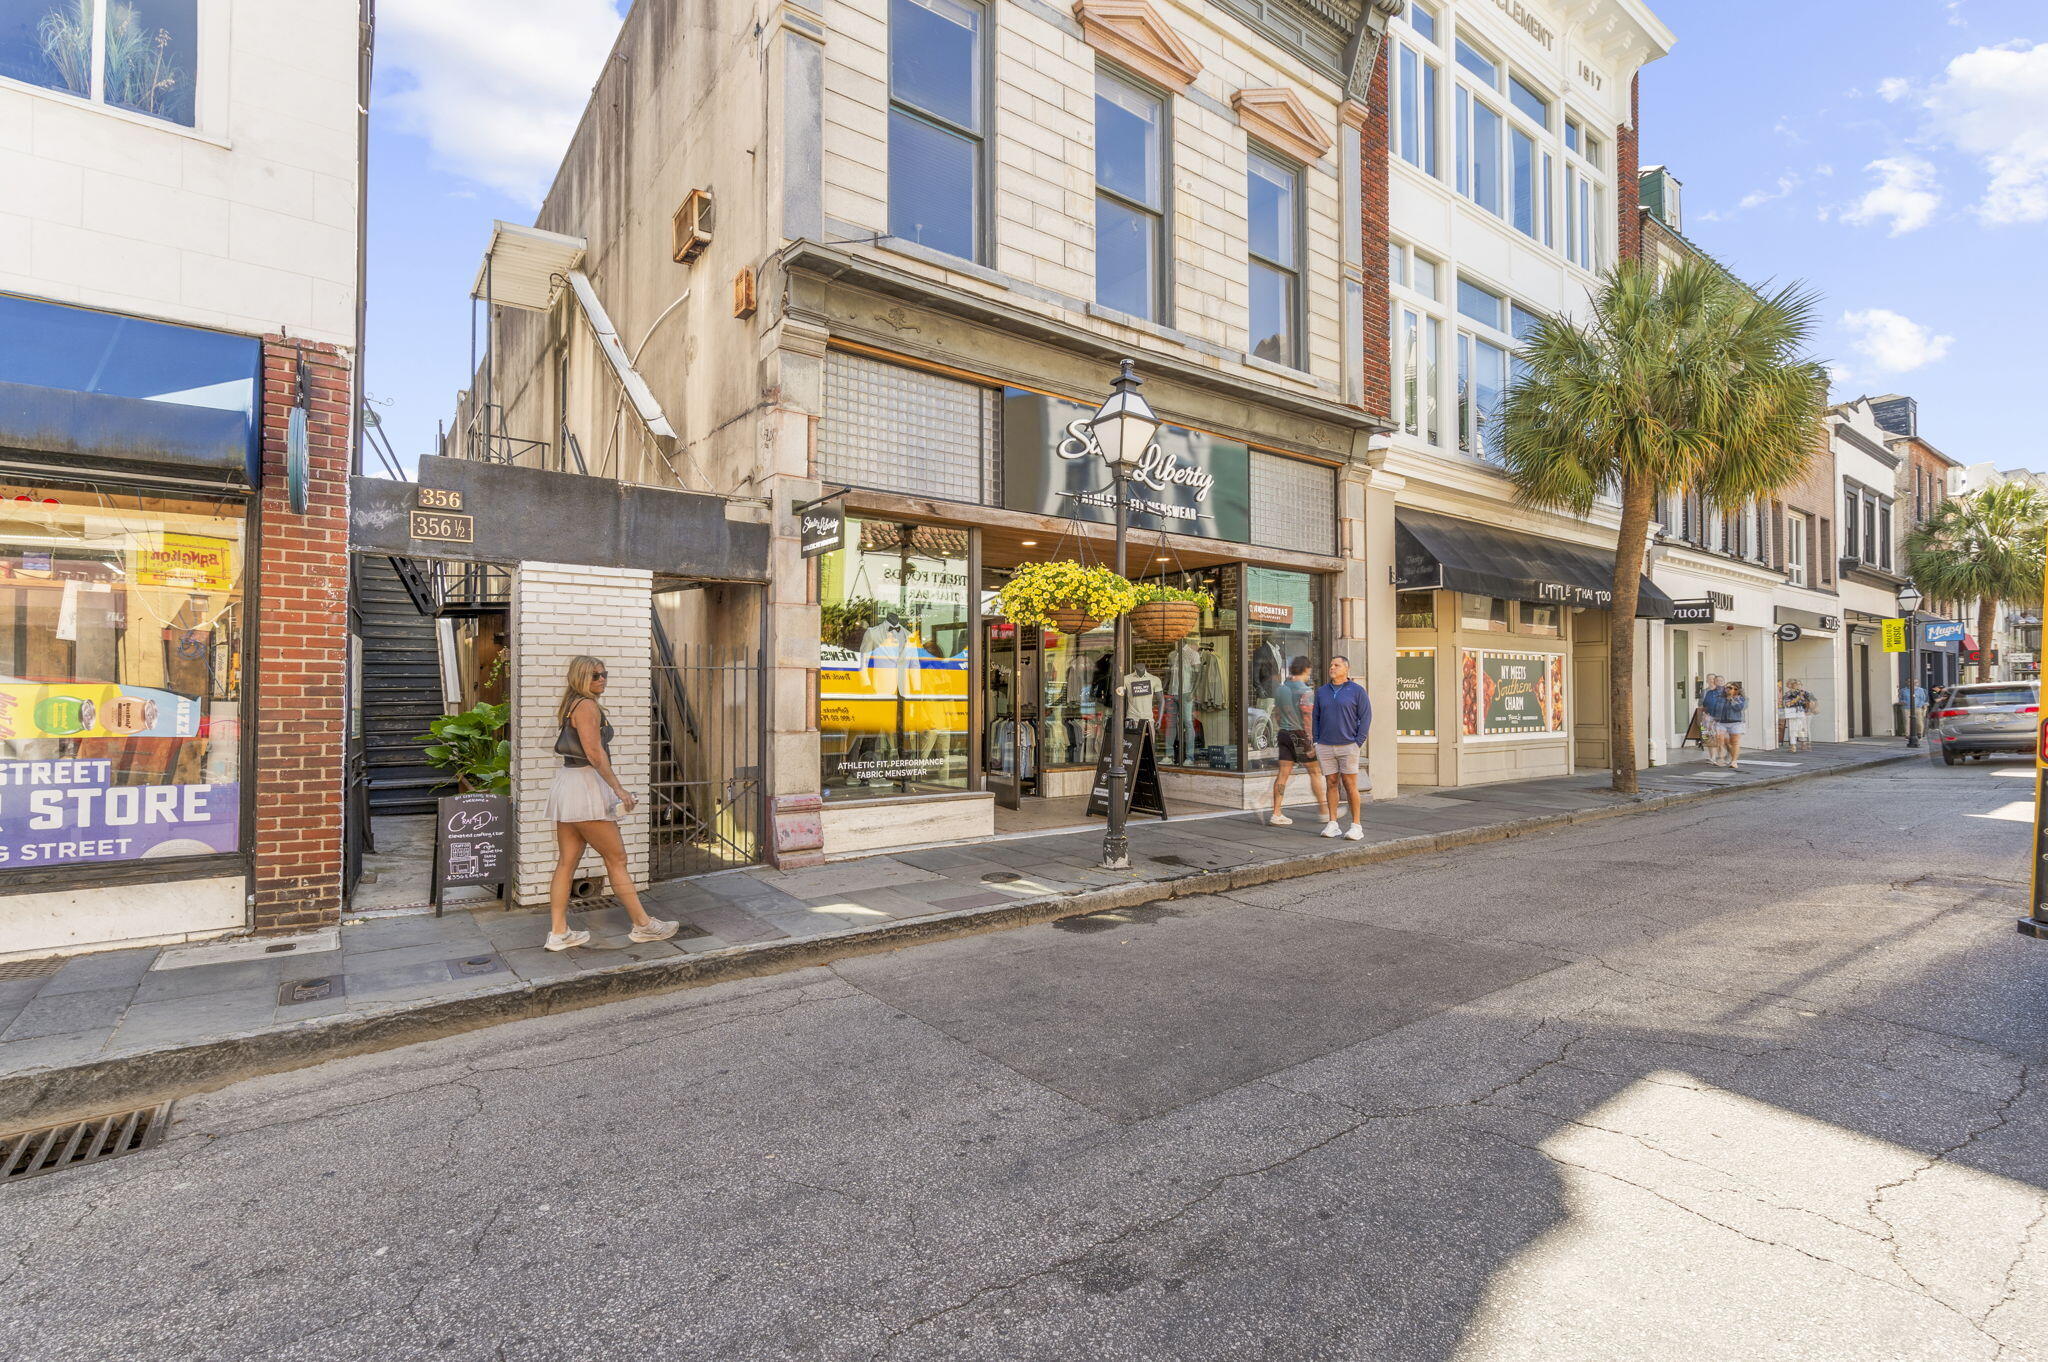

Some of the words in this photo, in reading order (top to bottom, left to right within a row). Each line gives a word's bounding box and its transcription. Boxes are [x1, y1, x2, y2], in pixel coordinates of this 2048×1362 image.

[1133, 443, 1214, 502] Liberty
[422, 489, 461, 508] 356
[416, 516, 451, 537] 356
[1539, 582, 1571, 601] LITTLE
[1574, 587, 1593, 602] THAI
[1595, 590, 1612, 605] TOO
[1780, 624, 1798, 640] S
[1893, 626, 1902, 645] MUSIC
[1927, 623, 1963, 641] Mugsy
[1501, 665, 1510, 679] NY
[1510, 665, 1527, 680] MEETS
[1396, 690, 1425, 700] COMING
[1504, 696, 1524, 711] CHARM
[1400, 700, 1421, 710] SOON
[837, 759, 875, 771] ATHLETIC
[876, 759, 890, 769] FIT,
[890, 757, 944, 768] PERFORMANCE
[856, 770, 884, 779] FABRIC
[884, 768, 928, 778] MENSWEAR
[29, 784, 212, 830] STORE
[20, 838, 133, 861] STREET
